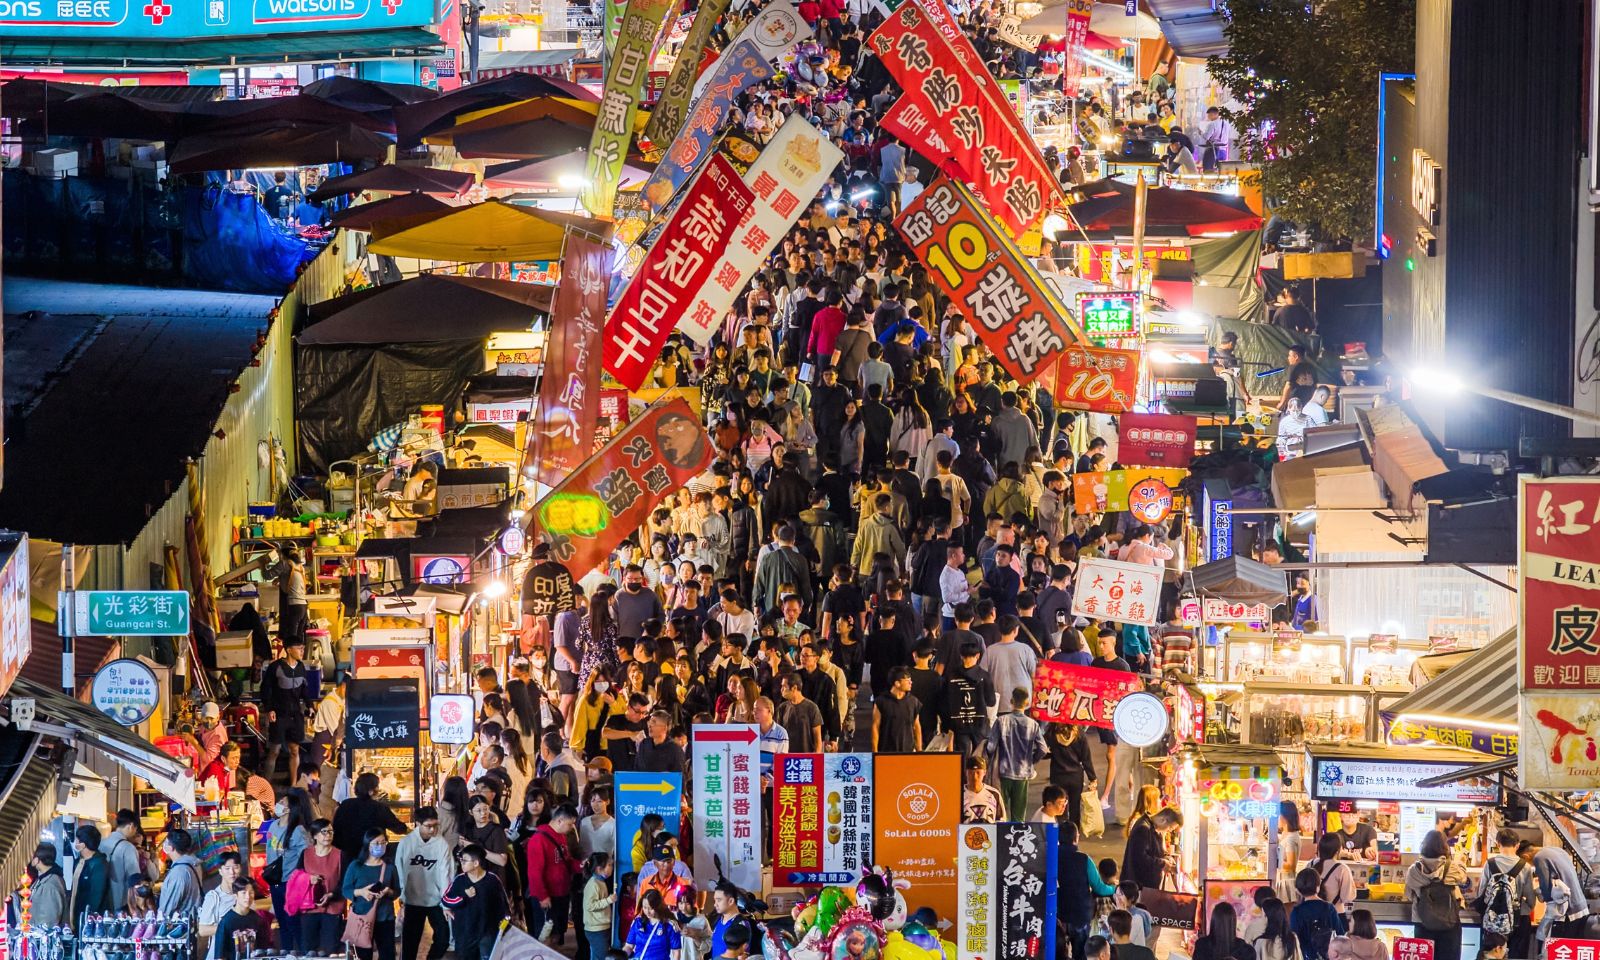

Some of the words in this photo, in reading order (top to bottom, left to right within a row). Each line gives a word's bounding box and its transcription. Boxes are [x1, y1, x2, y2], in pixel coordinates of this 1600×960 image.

[57, 1, 111, 17] 屈臣氏
[897, 33, 1042, 226] 香腸炒米腸
[900, 185, 961, 247] 邱記
[926, 221, 989, 290] 10
[964, 265, 1066, 376] 碳烤
[1067, 373, 1112, 400] 10
[1536, 489, 1600, 545] 紅
[1091, 571, 1145, 595] 大上海
[104, 595, 173, 616] 光彩街
[1084, 596, 1146, 620] 香酥雞
[105, 620, 154, 630] Guangcai
[157, 620, 171, 629] St.
[1548, 604, 1600, 656] 皮
[799, 758, 813, 783] 嘉義
[703, 754, 724, 839] 甘草芭樂
[733, 754, 751, 839] 蜜餞番茄
[902, 788, 934, 799] SOLALA
[779, 785, 797, 868] 美乃滋涼麵
[842, 785, 857, 871] 韓國拉絲熱狗
[906, 812, 930, 821] GOODS
[884, 829, 917, 838] SoLaLa
[920, 829, 951, 837] GOODS
[807, 872, 848, 882] 冷氣開放
[1003, 858, 1044, 958] 台南牛肉湯
[1161, 916, 1192, 929] SPACE
[1554, 945, 1600, 960] 全面
